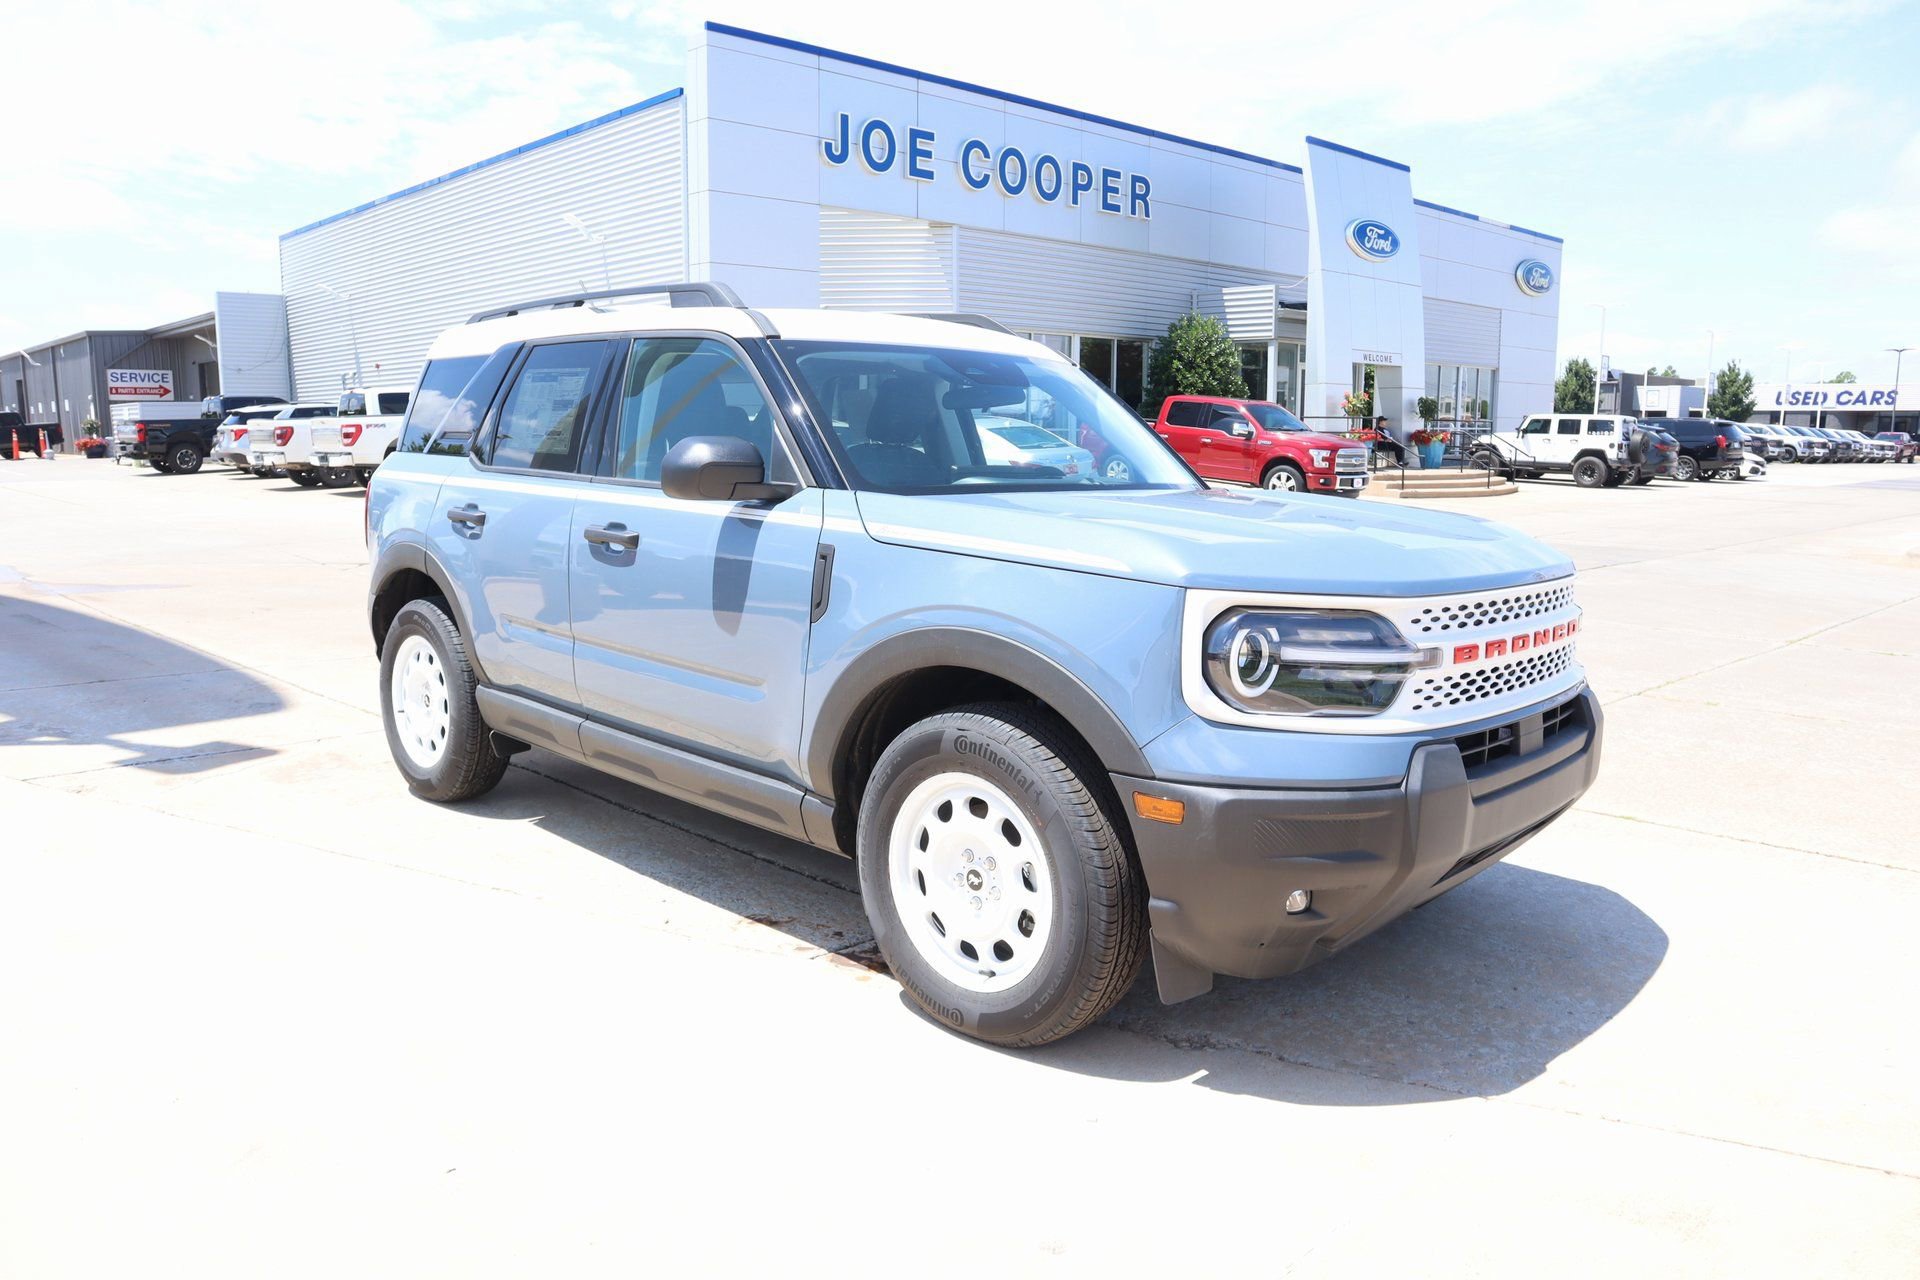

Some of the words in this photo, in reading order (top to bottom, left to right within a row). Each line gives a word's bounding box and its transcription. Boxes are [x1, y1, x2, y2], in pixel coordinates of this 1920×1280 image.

[822, 111, 937, 182] JOE
[959, 137, 1153, 221] COOPER
[1364, 226, 1393, 253] Ford
[1529, 267, 1552, 289] Ford
[1362, 353, 1393, 364] WELCOME
[110, 371, 170, 384] SERVICE
[136, 387, 164, 395] ENTRANCE
[1835, 389, 1898, 406] CARS
[1453, 618, 1578, 665] BRONCO
[953, 734, 1035, 793] Continental
